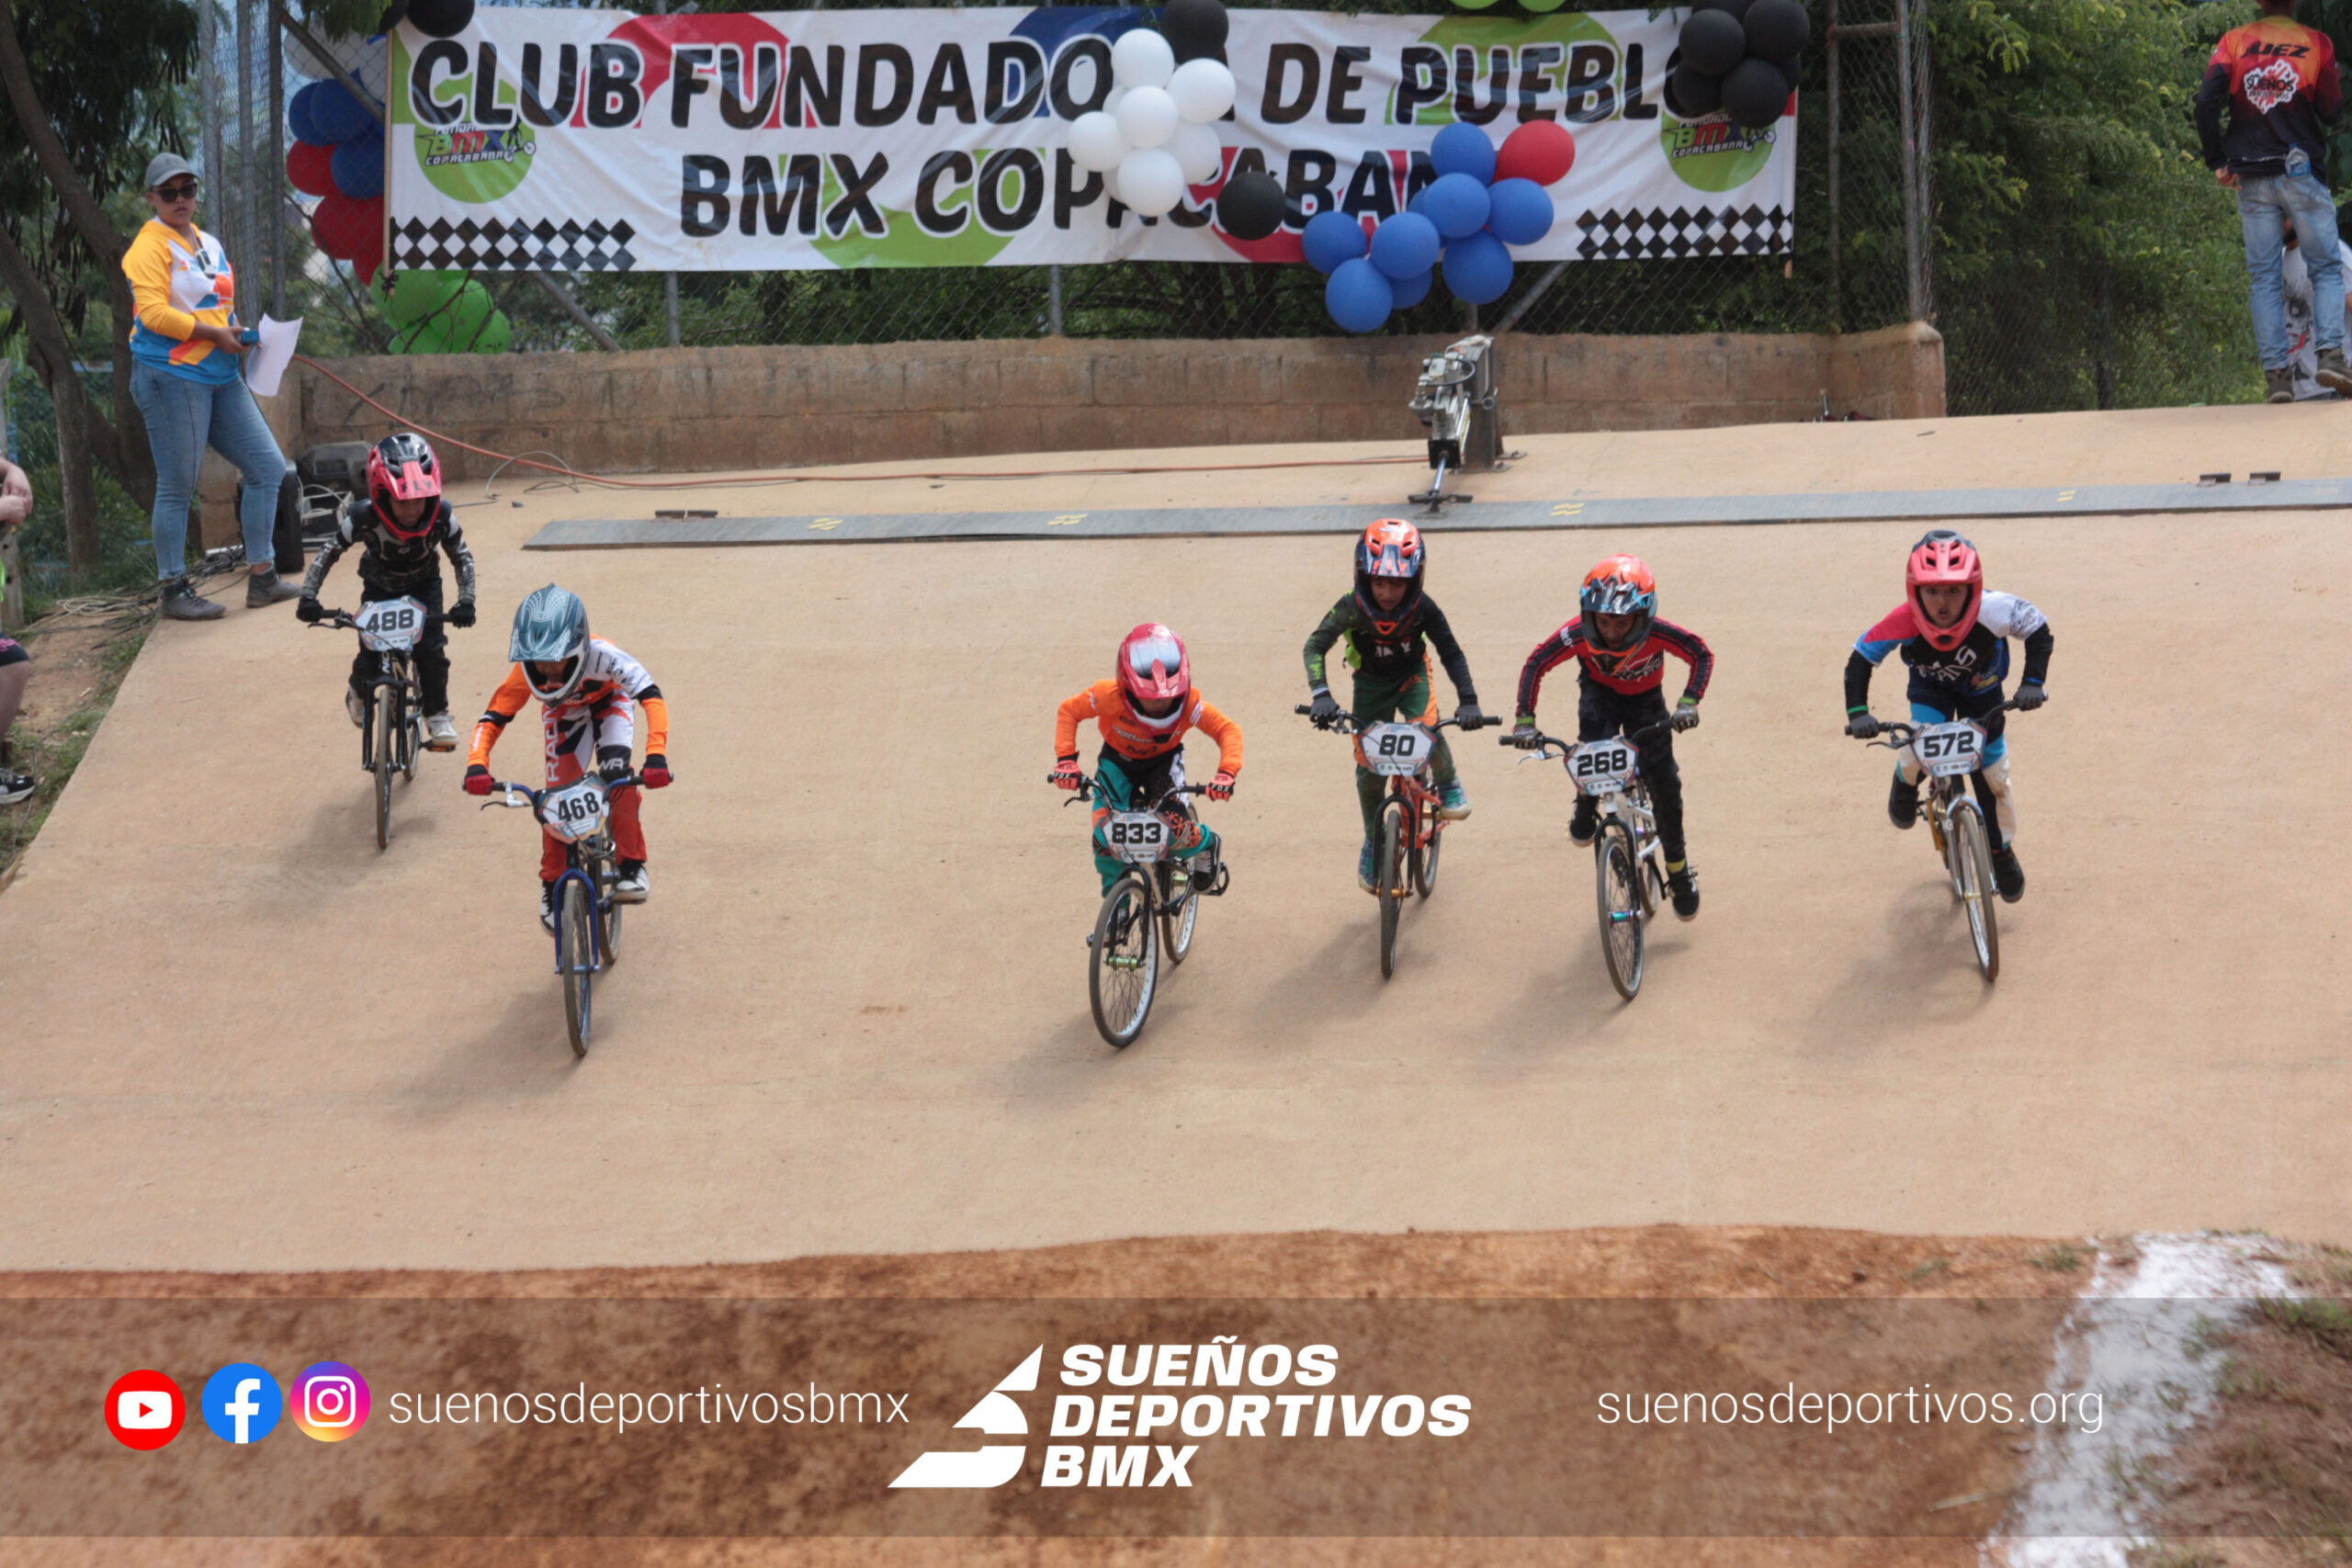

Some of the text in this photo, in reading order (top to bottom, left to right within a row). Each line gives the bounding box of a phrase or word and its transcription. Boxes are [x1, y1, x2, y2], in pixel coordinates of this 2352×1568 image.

[2241, 41, 2311, 59] JUEZ
[411, 39, 1716, 128] CLUB FUNDADO DE PUEBL
[428, 130, 505, 156] BMX
[1674, 121, 1744, 149] BMX
[680, 151, 889, 237] BMX
[366, 608, 414, 633] 488
[1379, 734, 1416, 757] 80
[1924, 730, 1974, 758] 572
[1577, 749, 1627, 777] 268
[558, 792, 599, 822] 468
[1112, 822, 1161, 844] 833
